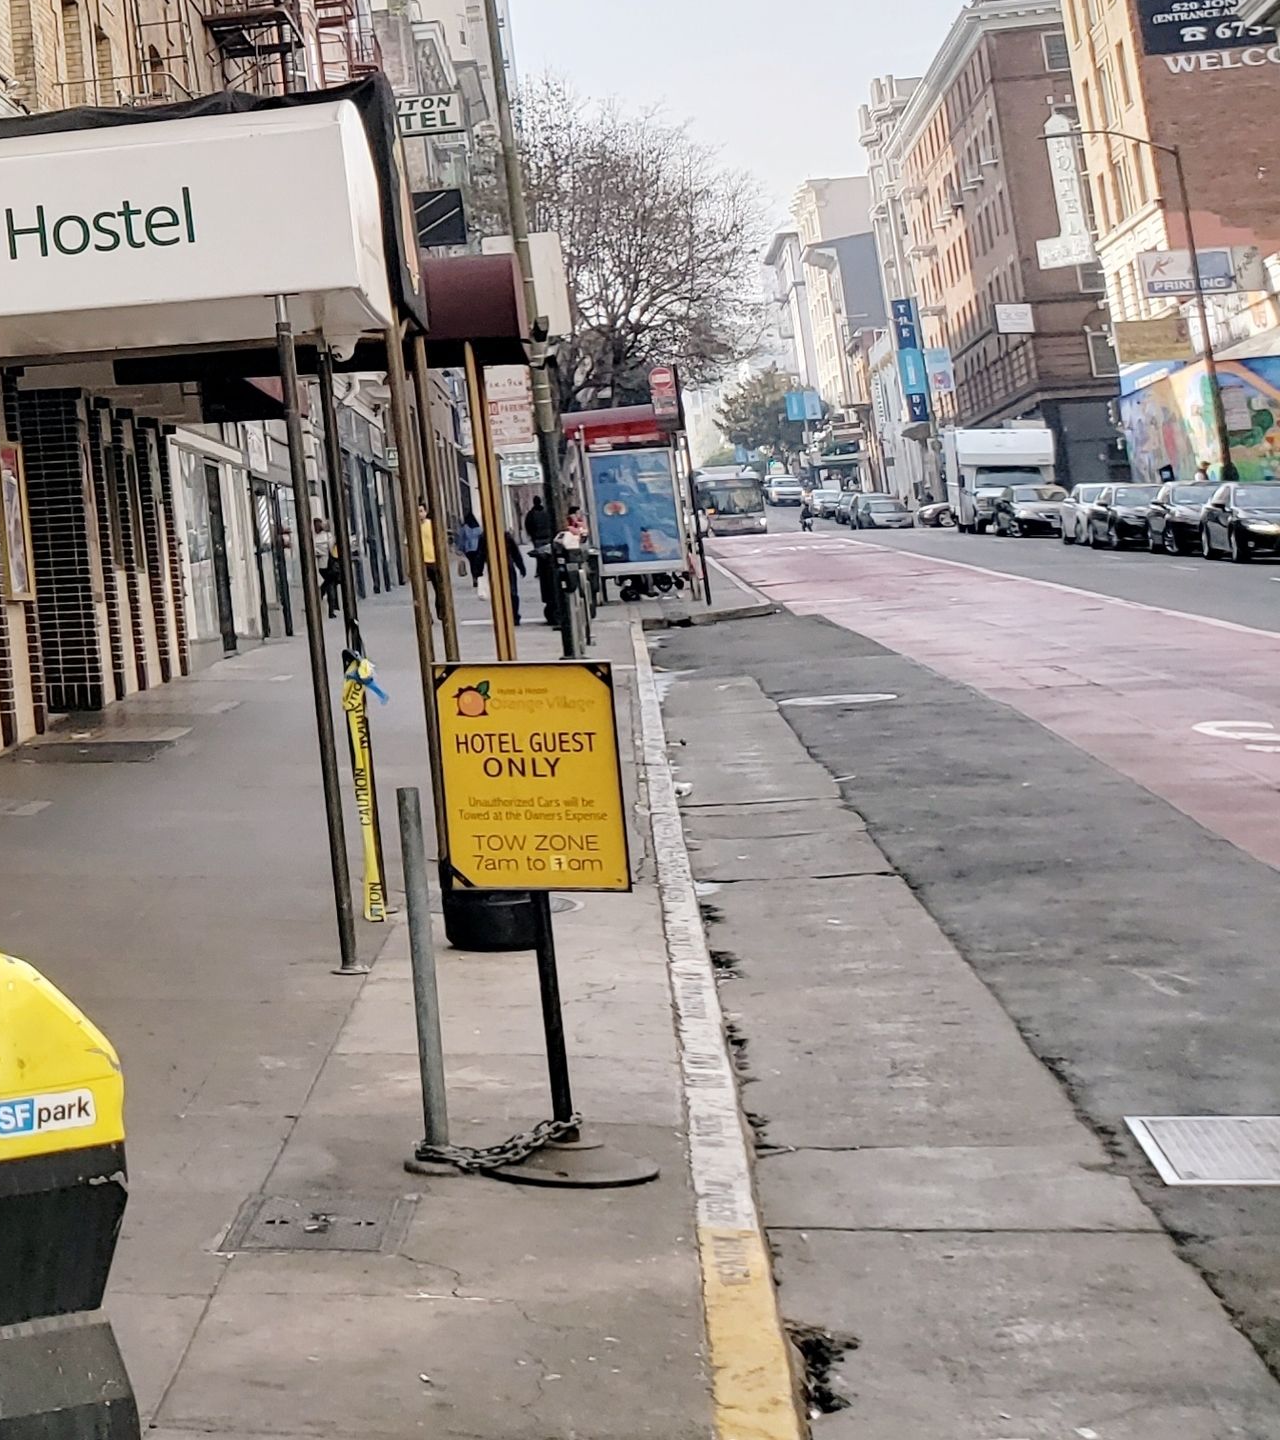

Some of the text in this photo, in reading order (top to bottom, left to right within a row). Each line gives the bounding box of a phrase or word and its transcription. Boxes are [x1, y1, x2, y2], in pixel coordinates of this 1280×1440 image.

[4, 185, 197, 261] Hostel
[1153, 275, 1227, 292] PRINTNG
[455, 732, 597, 754] HOTEL GUEST
[483, 757, 561, 778] ONLY
[354, 767, 371, 827] CAUTION
[468, 796, 595, 808] Unauthorized Cars will be
[458, 809, 490, 821] Towed
[492, 810, 503, 821] at
[505, 809, 521, 821] the
[565, 809, 608, 823] Expense
[472, 834, 600, 851] TOW ZONE
[472, 854, 519, 871] 7am
[527, 855, 546, 871] to
